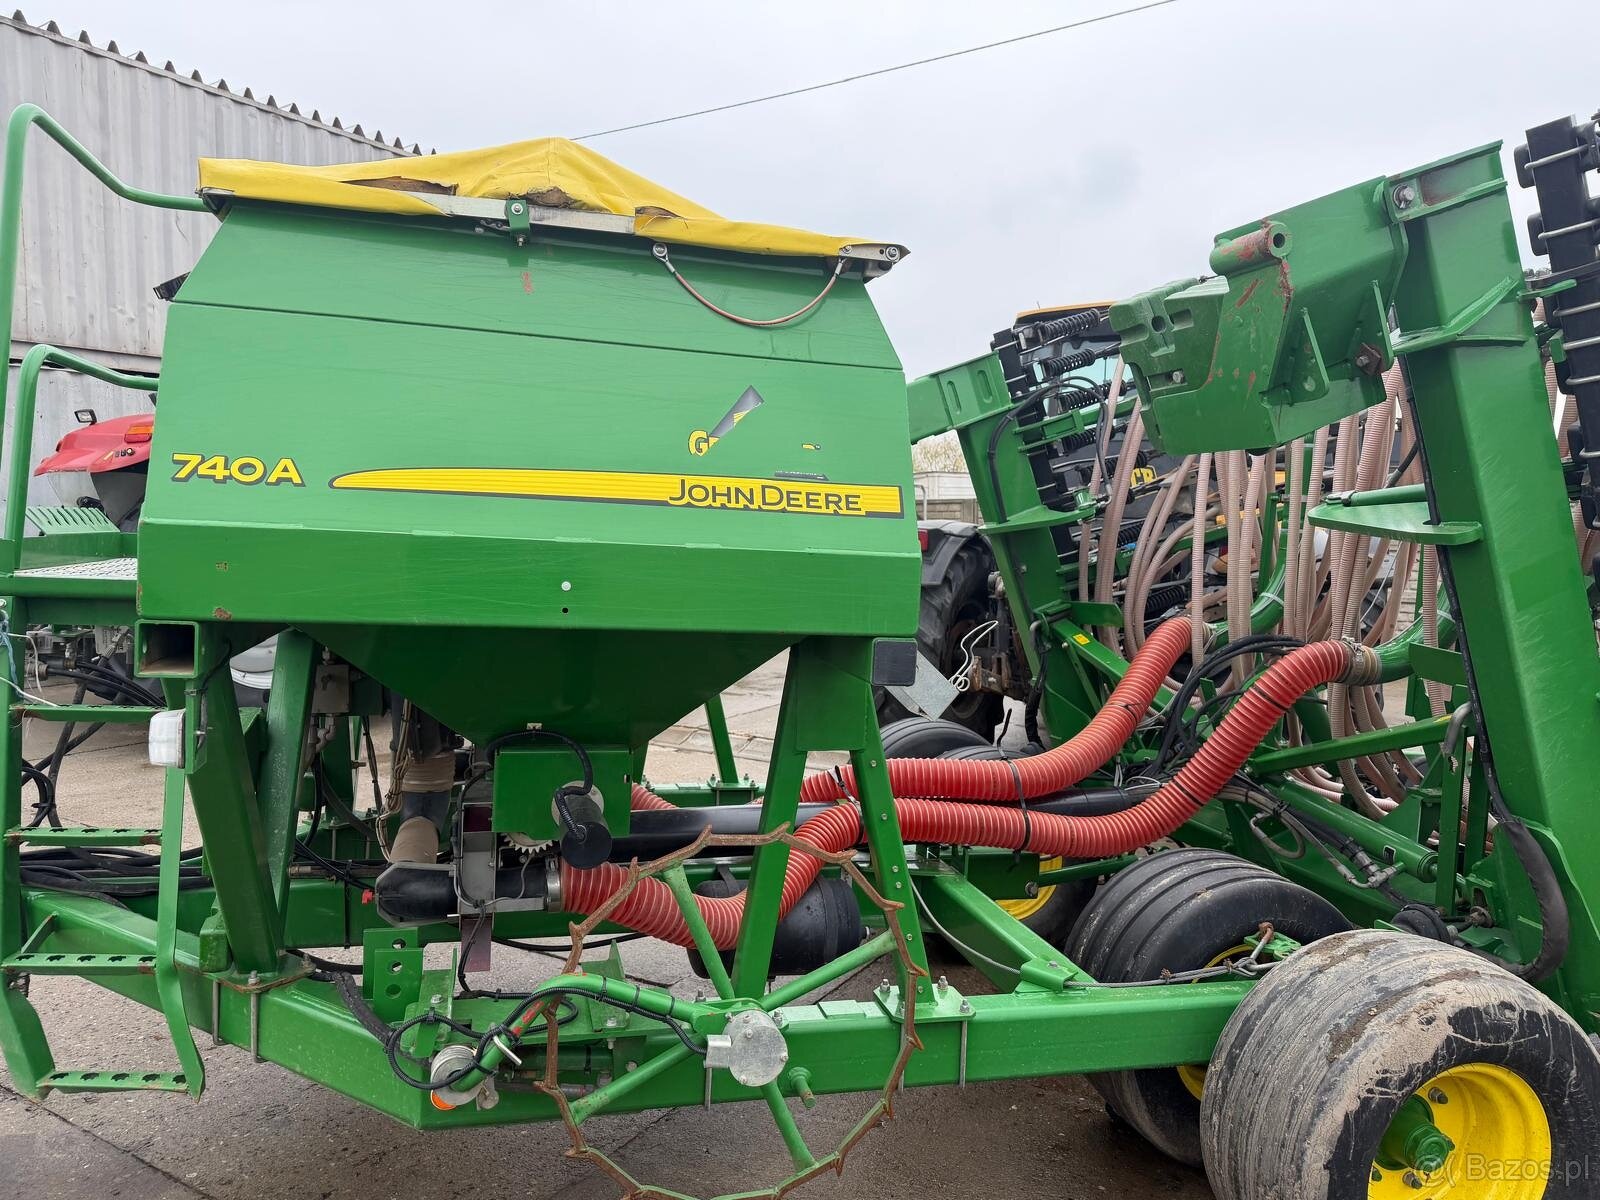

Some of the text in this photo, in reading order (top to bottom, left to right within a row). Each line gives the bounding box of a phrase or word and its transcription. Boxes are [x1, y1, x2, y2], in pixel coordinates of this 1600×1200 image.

[172, 453, 305, 487] 740A
[669, 478, 862, 512] JOHN DEERE
